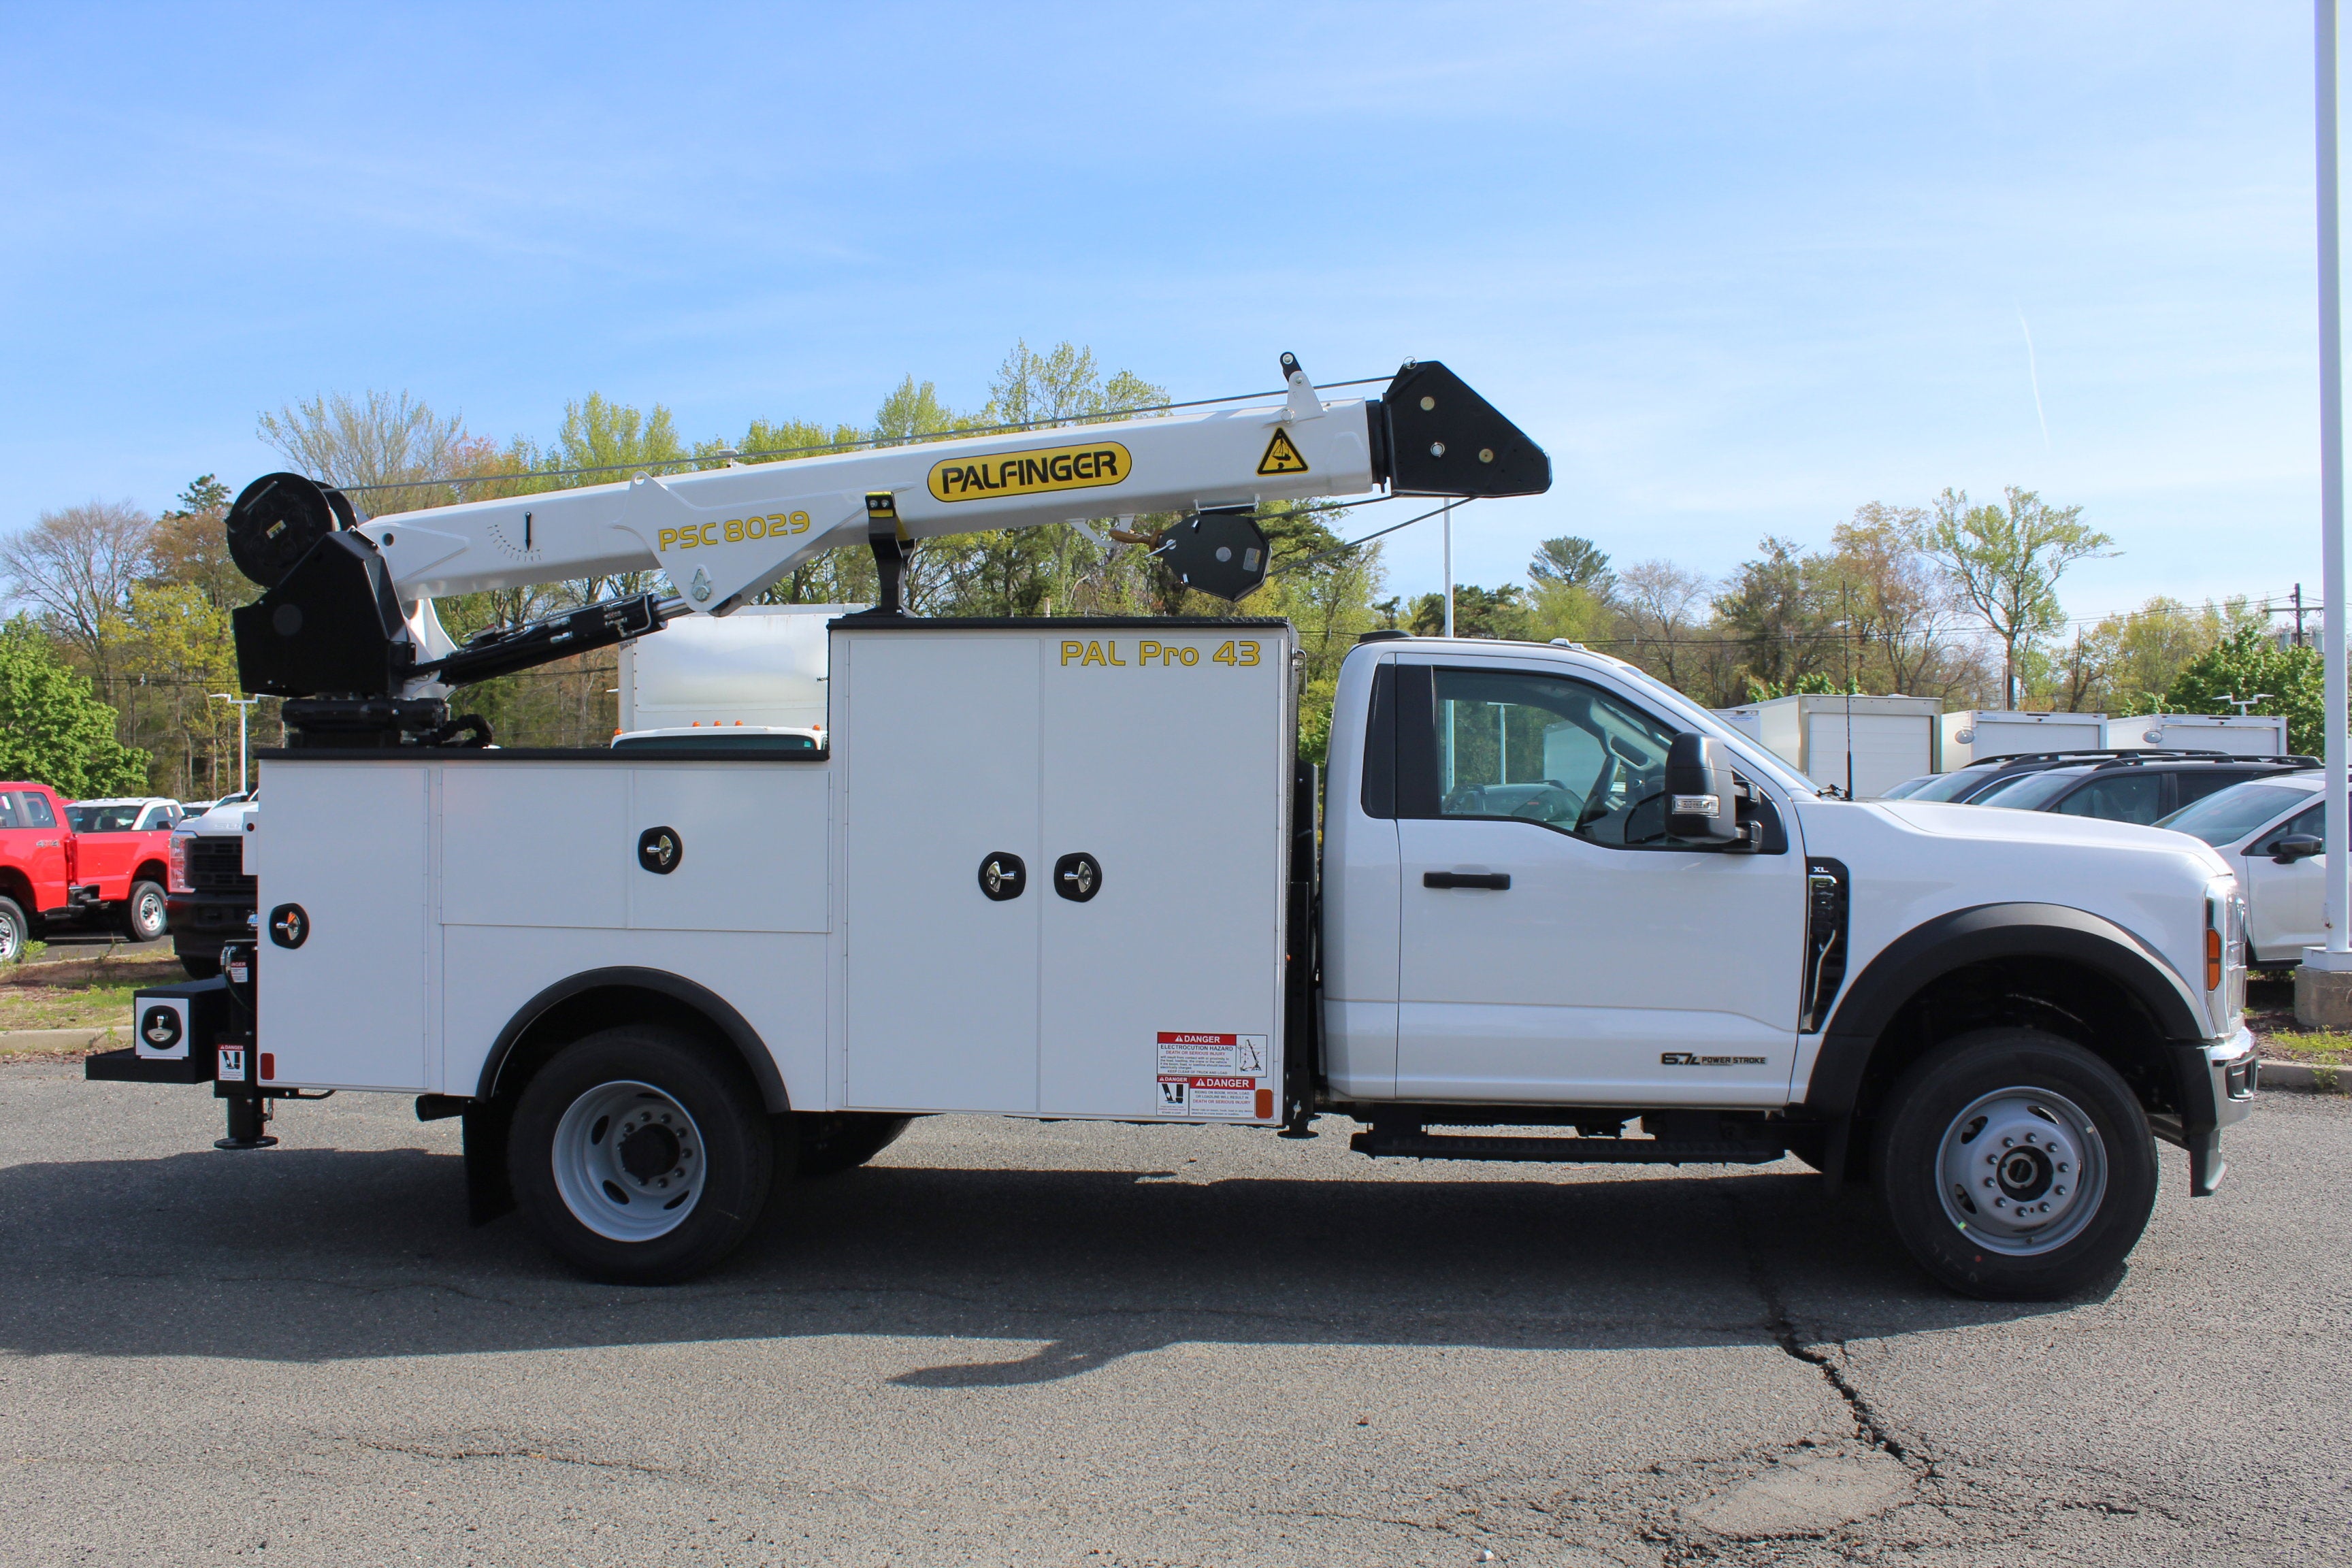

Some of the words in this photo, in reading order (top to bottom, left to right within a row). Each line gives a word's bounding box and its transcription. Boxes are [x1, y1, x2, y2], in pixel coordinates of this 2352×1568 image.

[941, 450, 1118, 494] PALFINGER
[658, 522, 718, 552] PSC
[723, 510, 810, 542] 8029
[1061, 641, 1126, 666] PAL
[1139, 641, 1199, 666] Pro
[1213, 641, 1260, 666] 43
[1661, 1052, 1700, 1065] 6.7L
[1207, 1079, 1249, 1087] DANGER
